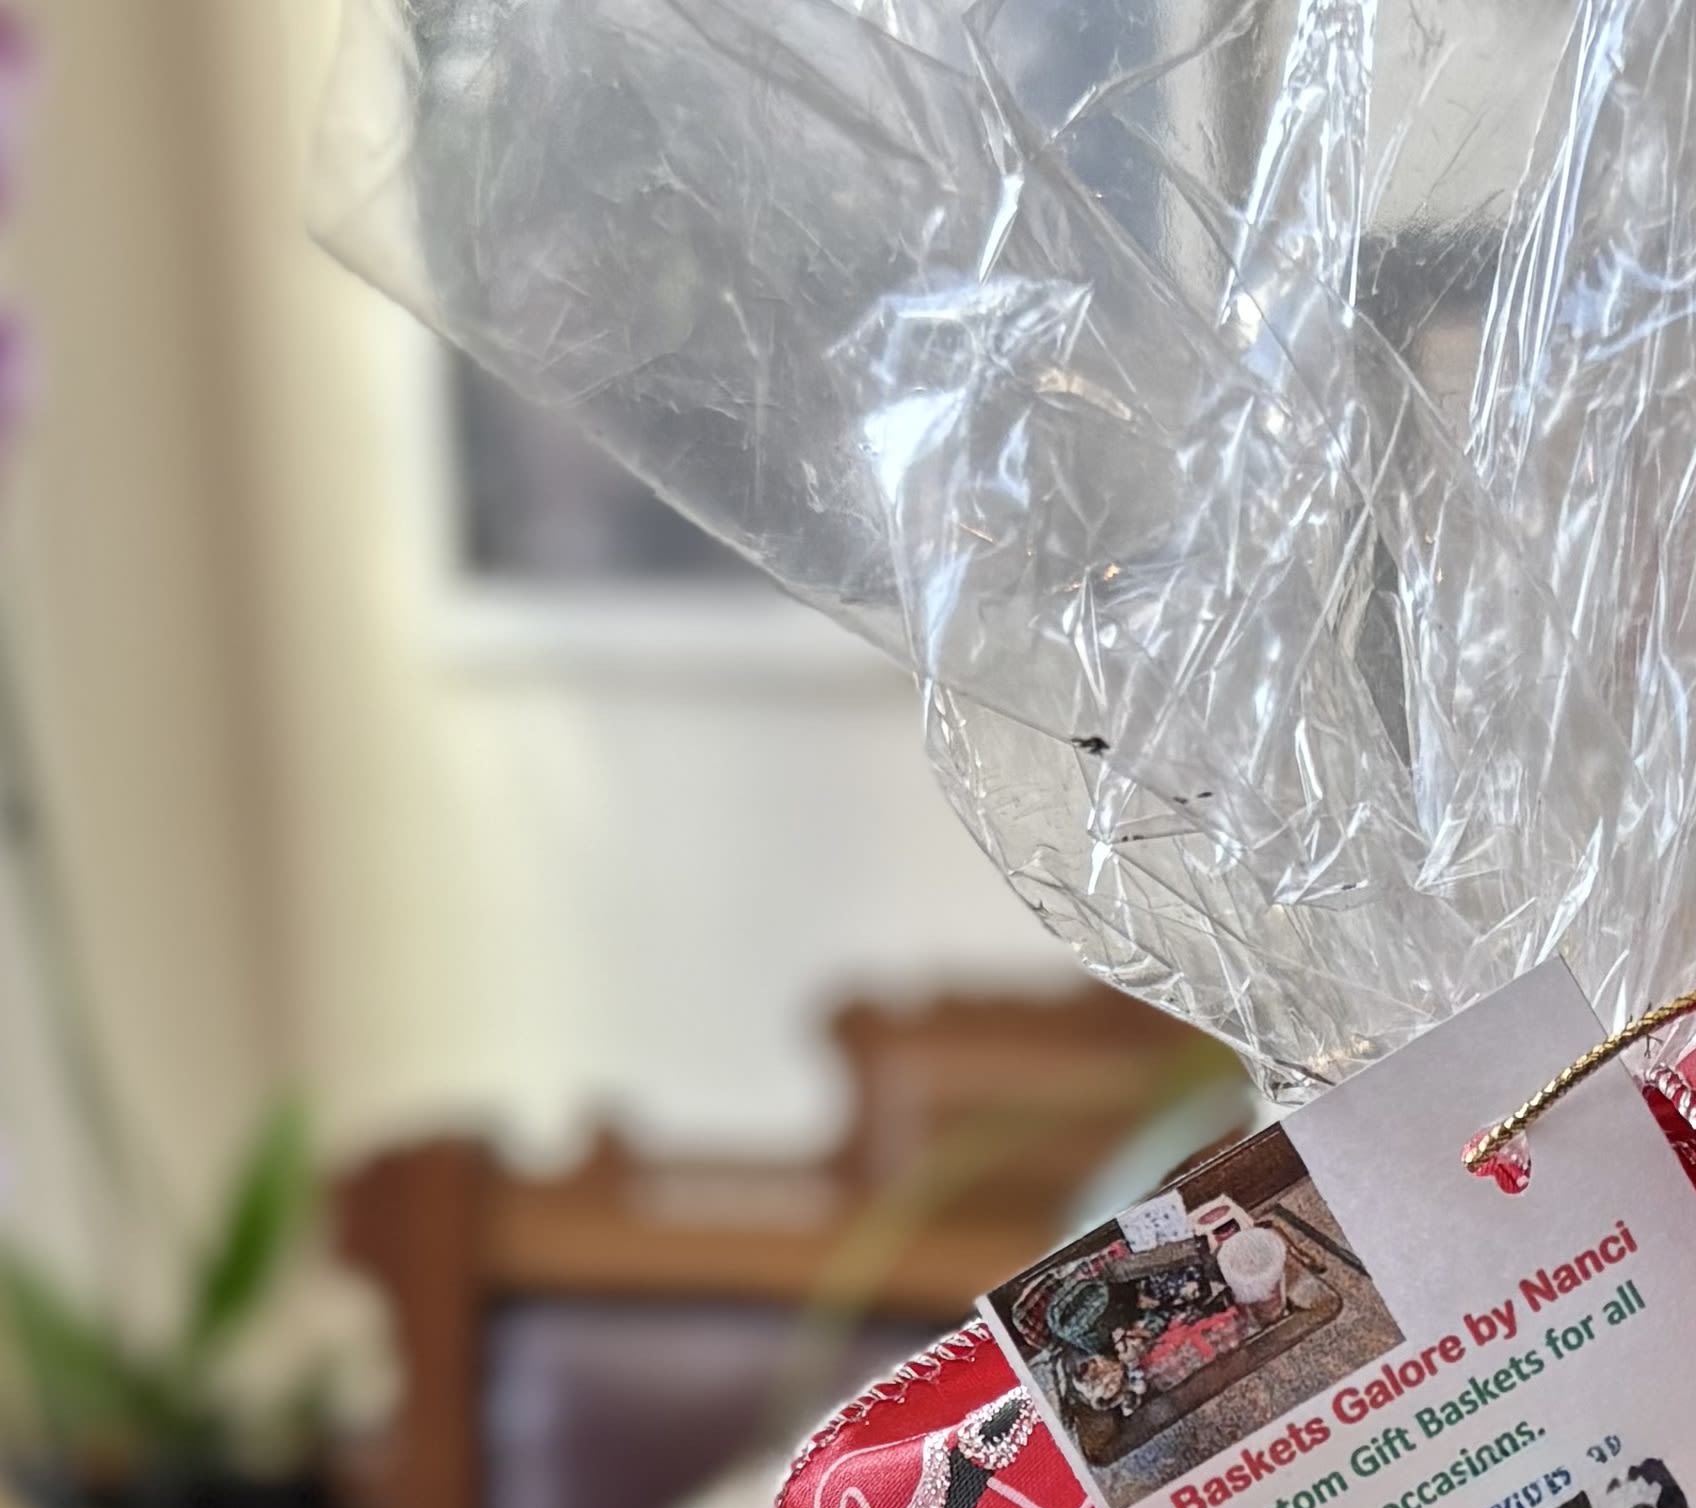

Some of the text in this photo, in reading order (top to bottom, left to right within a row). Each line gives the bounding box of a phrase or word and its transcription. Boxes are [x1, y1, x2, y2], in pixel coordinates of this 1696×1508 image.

[1331, 1332, 1467, 1426] Galore
[1463, 1301, 1519, 1348] by
[1518, 1220, 1639, 1313] Nanci
[1350, 1425, 1418, 1481] Gift
[1414, 1345, 1546, 1440] Baskets
[1544, 1312, 1598, 1361] for
[1602, 1279, 1647, 1326] all
